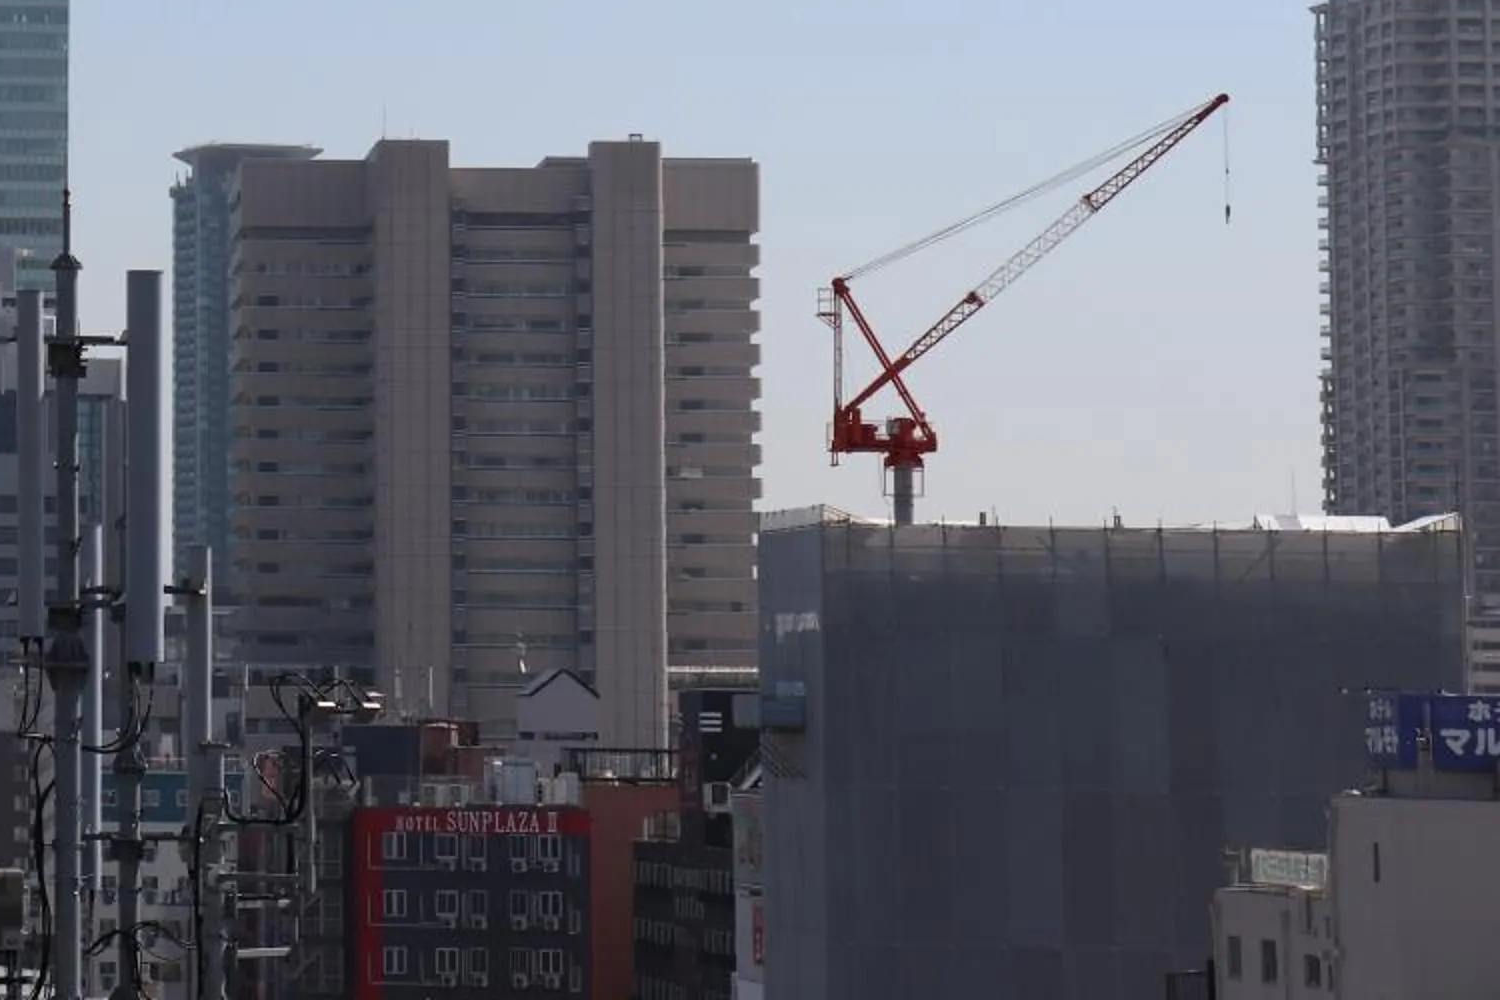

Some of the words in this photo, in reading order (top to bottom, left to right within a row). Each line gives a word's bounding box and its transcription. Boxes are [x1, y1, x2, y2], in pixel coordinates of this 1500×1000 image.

[1439, 727, 1500, 756] マル
[395, 815, 439, 831] HOTEL
[446, 810, 540, 833] SUNPLAZA
